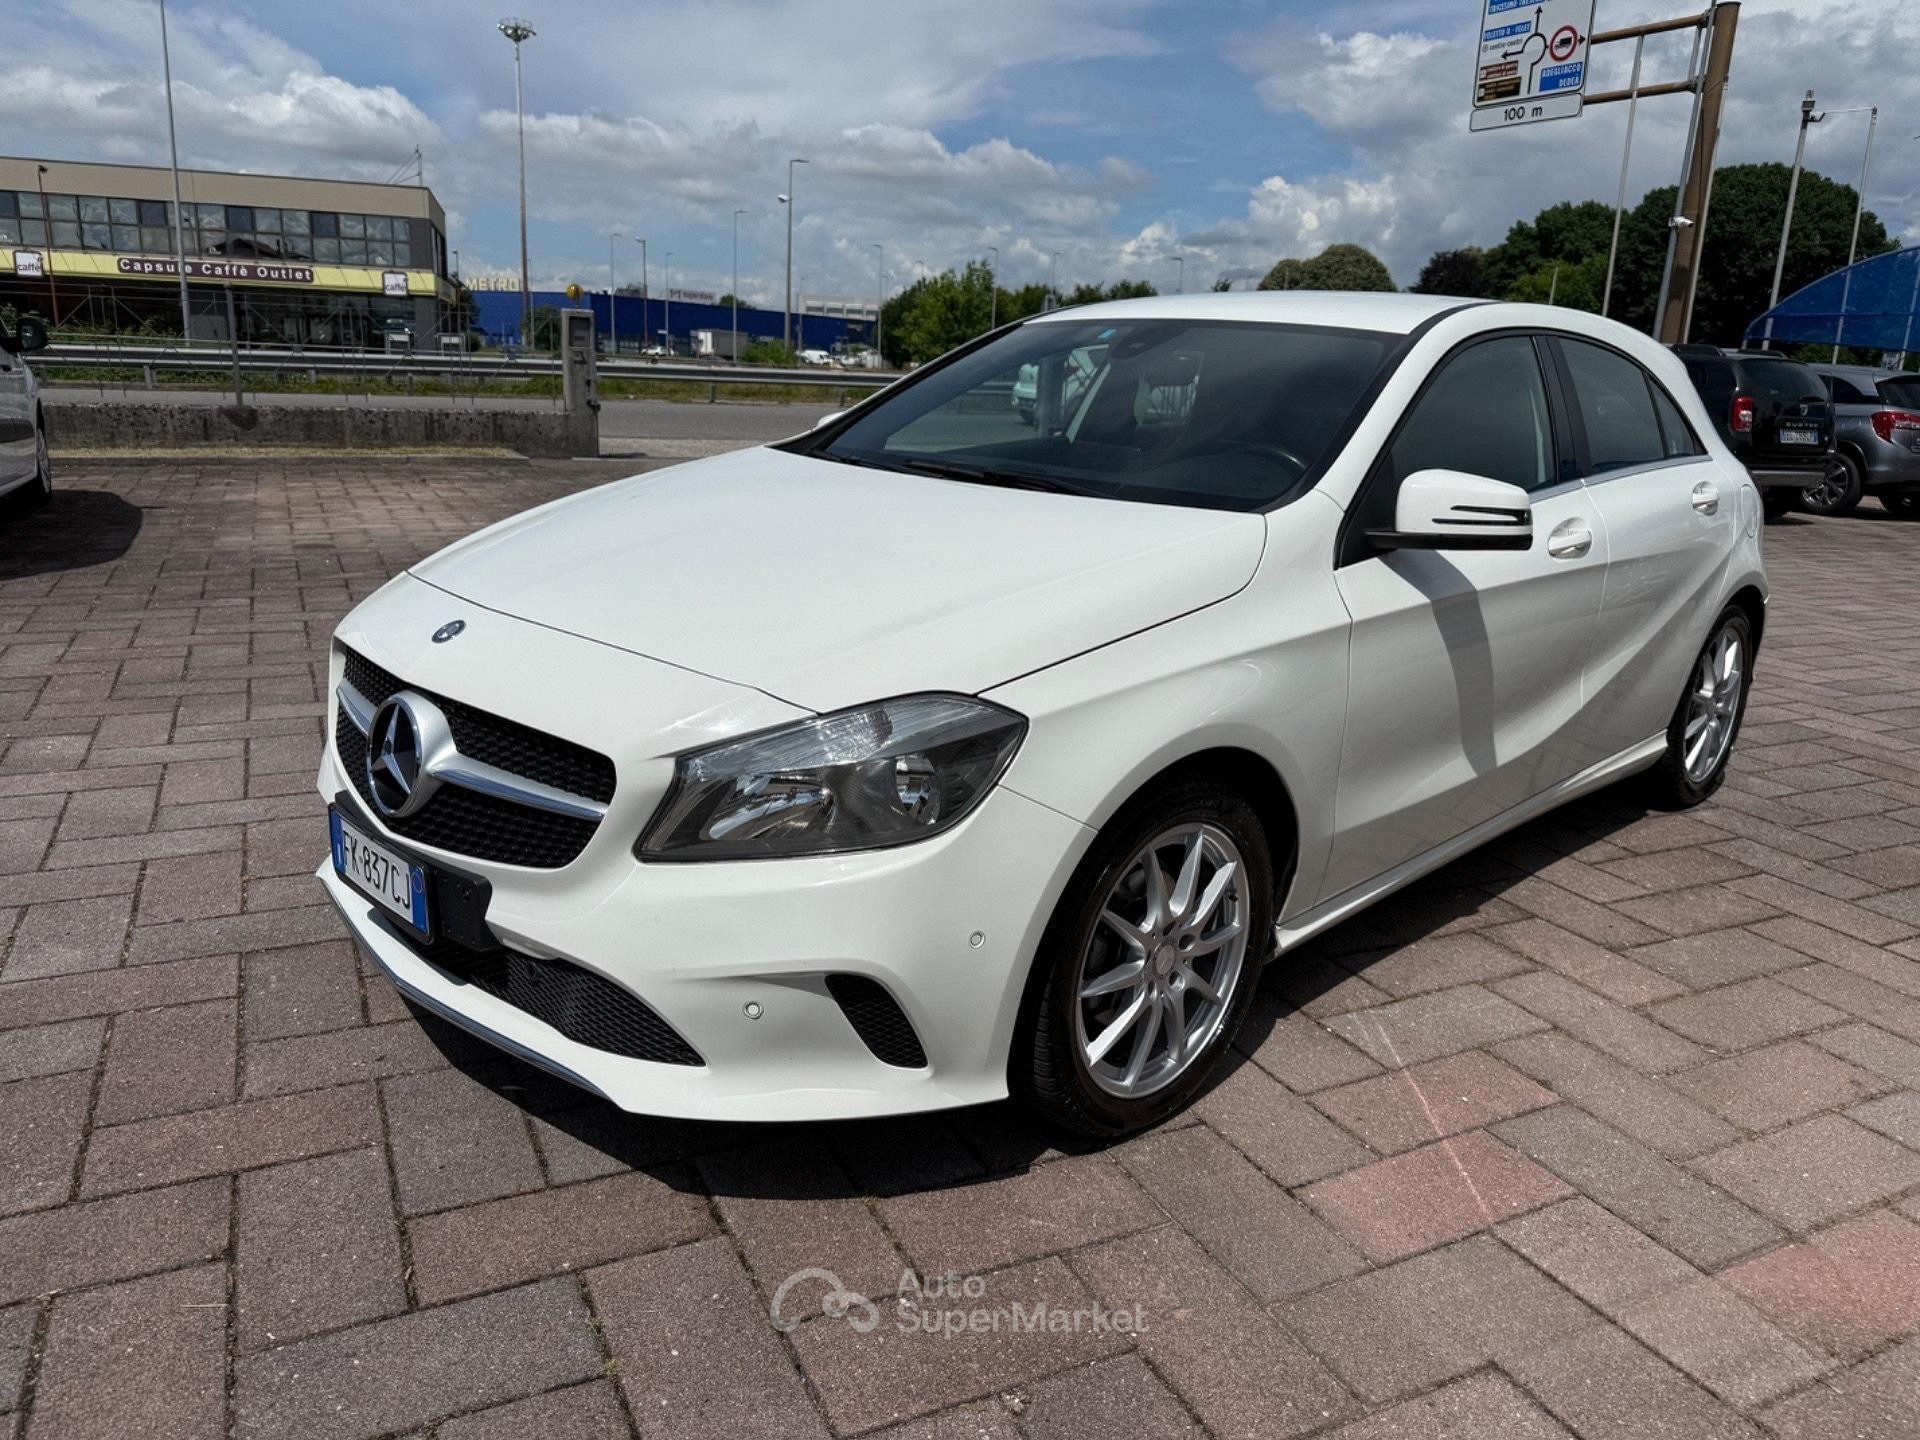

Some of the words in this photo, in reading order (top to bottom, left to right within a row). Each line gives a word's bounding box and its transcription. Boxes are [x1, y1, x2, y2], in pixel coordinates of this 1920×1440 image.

[1504, 106, 1525, 121] 100
[1531, 105, 1543, 117] m
[201, 263, 249, 277] Caffè
[256, 266, 312, 281] Outlet
[465, 277, 520, 291] METRO
